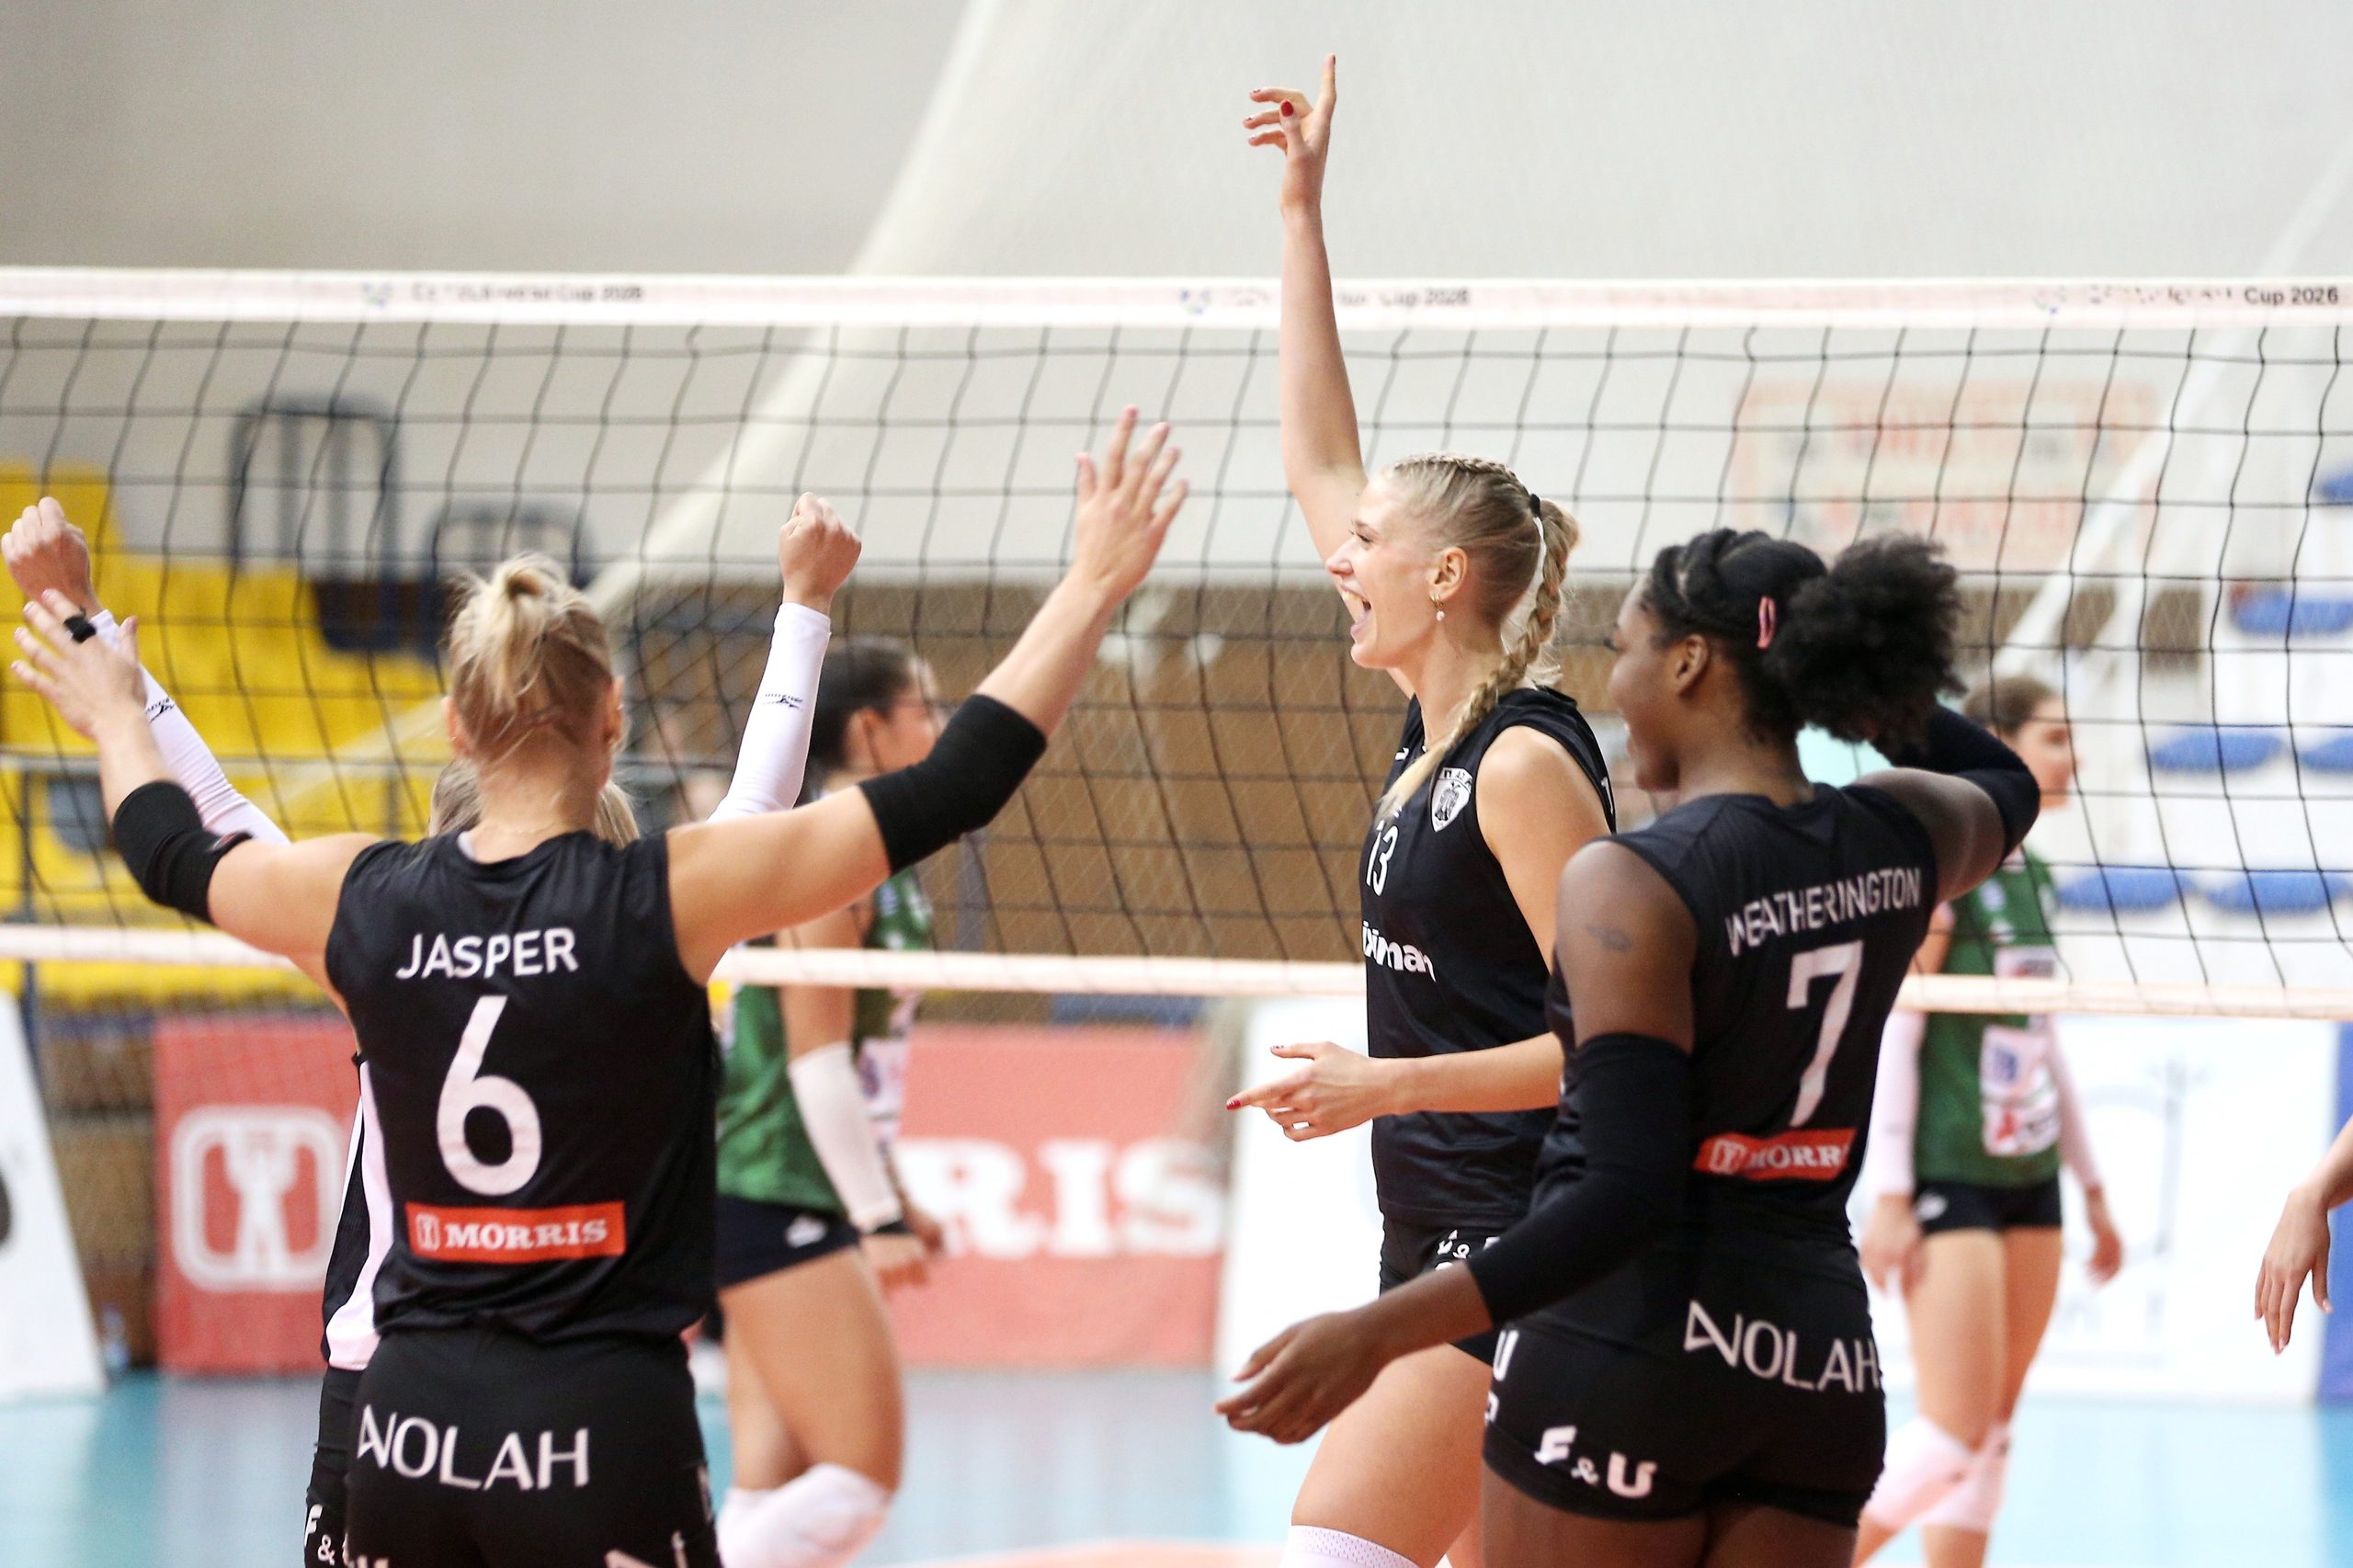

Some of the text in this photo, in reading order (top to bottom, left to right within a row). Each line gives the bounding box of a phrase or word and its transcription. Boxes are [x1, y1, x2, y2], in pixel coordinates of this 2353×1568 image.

[2244, 286, 2285, 307] Cup
[2291, 284, 2339, 306] 2026
[1724, 867, 1922, 957] WEATHERINGTON
[396, 927, 578, 979] JASPER
[1787, 939, 1864, 1127] 7
[437, 995, 542, 1196] 6
[1747, 1144, 1849, 1169] MORR
[445, 1219, 608, 1250] MORRIS
[357, 1404, 589, 1491] NOLAH
